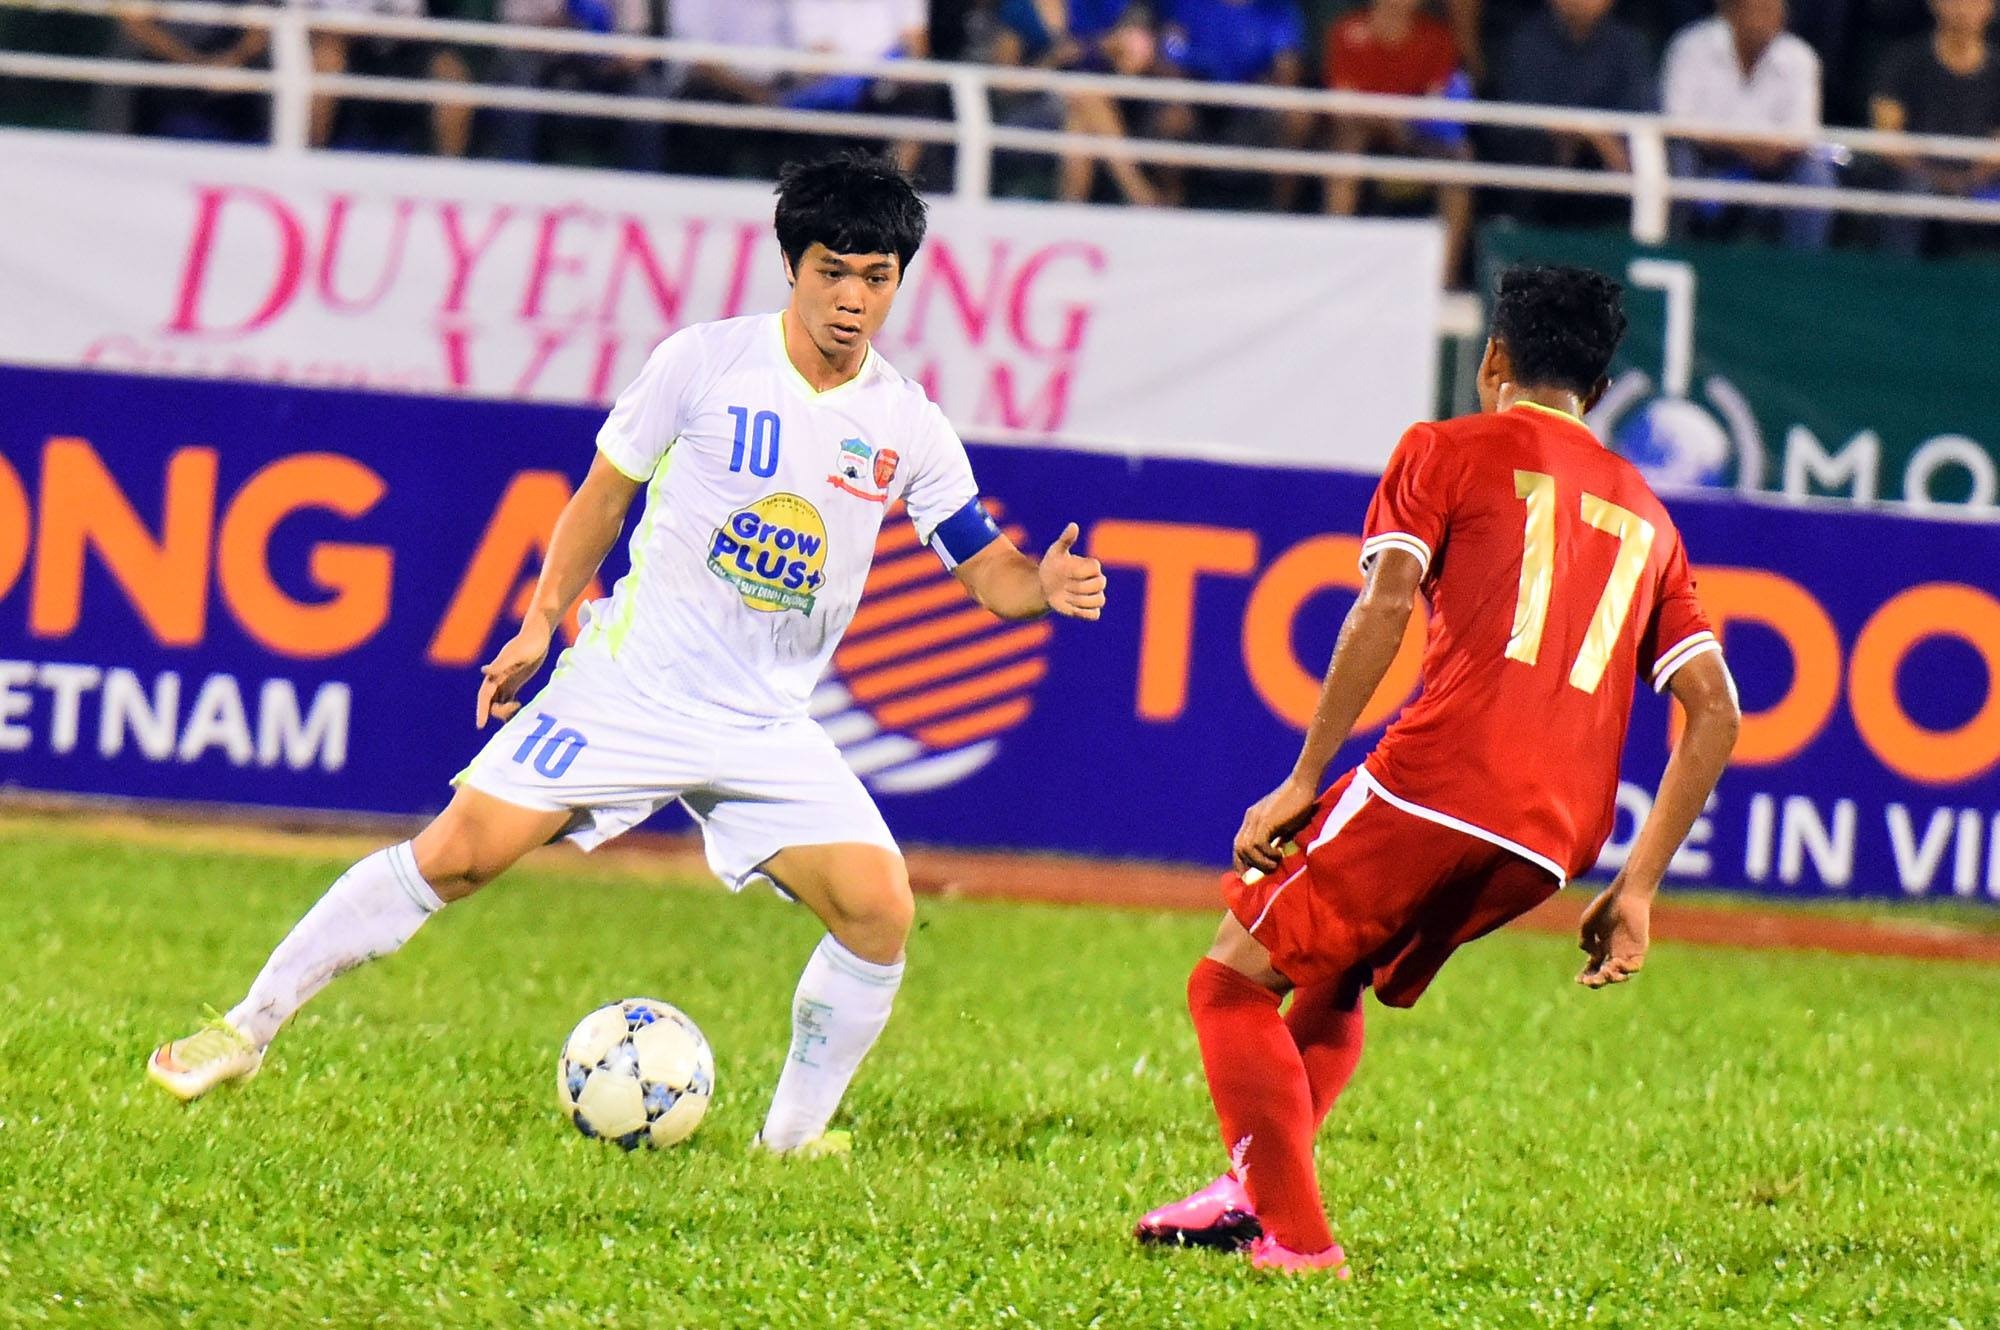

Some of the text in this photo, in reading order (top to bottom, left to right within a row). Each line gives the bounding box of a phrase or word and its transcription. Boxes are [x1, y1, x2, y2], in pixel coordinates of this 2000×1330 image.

[727, 405, 781, 479] 10
[712, 531, 821, 590] PLUS+
[732, 512, 821, 557] Grow
[1503, 468, 1656, 695] 17
[512, 712, 588, 779] 10
[1744, 791, 1858, 888] IN
